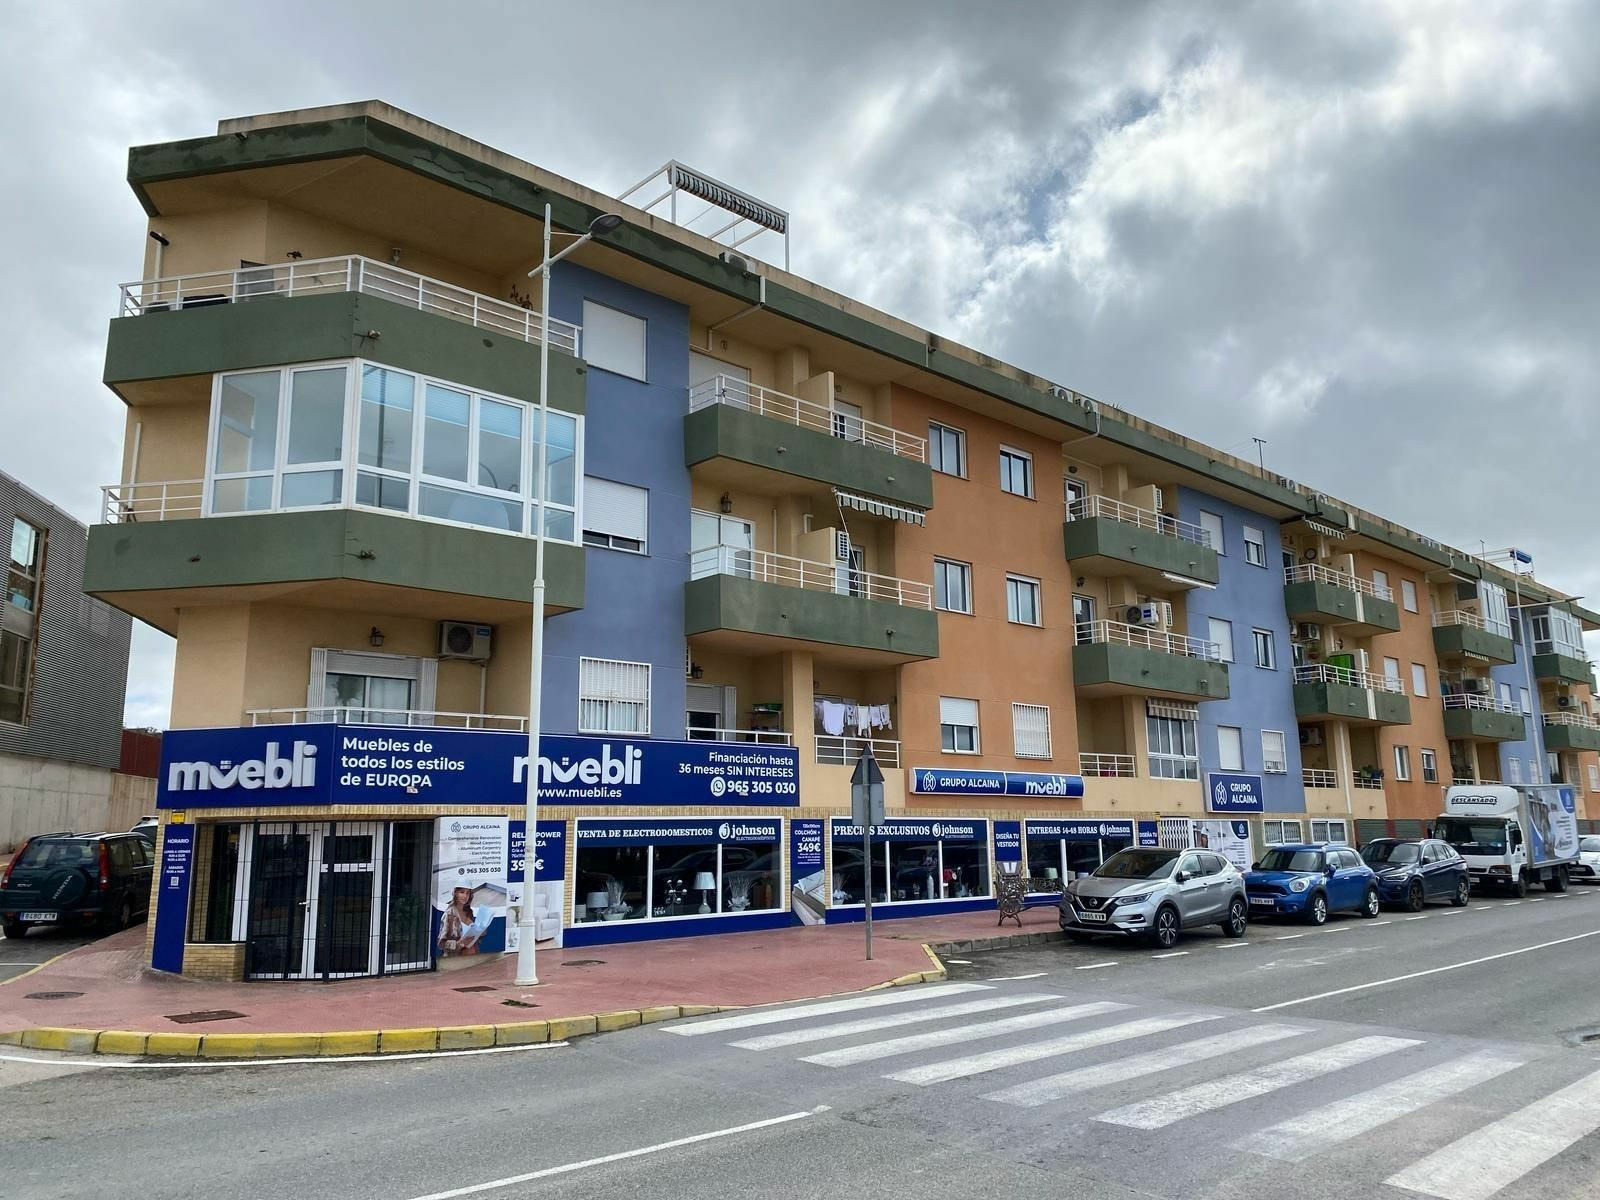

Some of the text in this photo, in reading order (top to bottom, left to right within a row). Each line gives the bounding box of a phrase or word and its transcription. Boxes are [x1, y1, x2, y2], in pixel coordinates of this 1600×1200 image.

[343, 737, 433, 753] Muebles de
[341, 755, 465, 770] todos los estilos
[512, 744, 642, 785] muebli
[709, 752, 793, 766] Financiación hasta
[167, 740, 318, 791] muebli
[679, 763, 794, 778] 36 meses SIN INTERESES
[340, 772, 432, 787] de EUROPA
[940, 778, 1000, 789] GRUPO ALCAINA
[1025, 776, 1067, 795] muebli
[537, 787, 622, 798] www.muebli.es
[727, 781, 796, 794] 965 305 030
[1230, 783, 1251, 792] GRUPO
[1231, 795, 1258, 804] ALCAINA
[578, 830, 607, 838] VENTA
[623, 828, 713, 838] ELECTRODOMESTICOS
[730, 824, 776, 839] johnson
[833, 825, 930, 836] PRECIS EXCLUSIVOS
[941, 825, 974, 836] johnson
[996, 832, 1013, 840] DISEÑA
[1106, 825, 1130, 835] johnson
[797, 843, 821, 852] 349€
[511, 859, 544, 871] 39€
